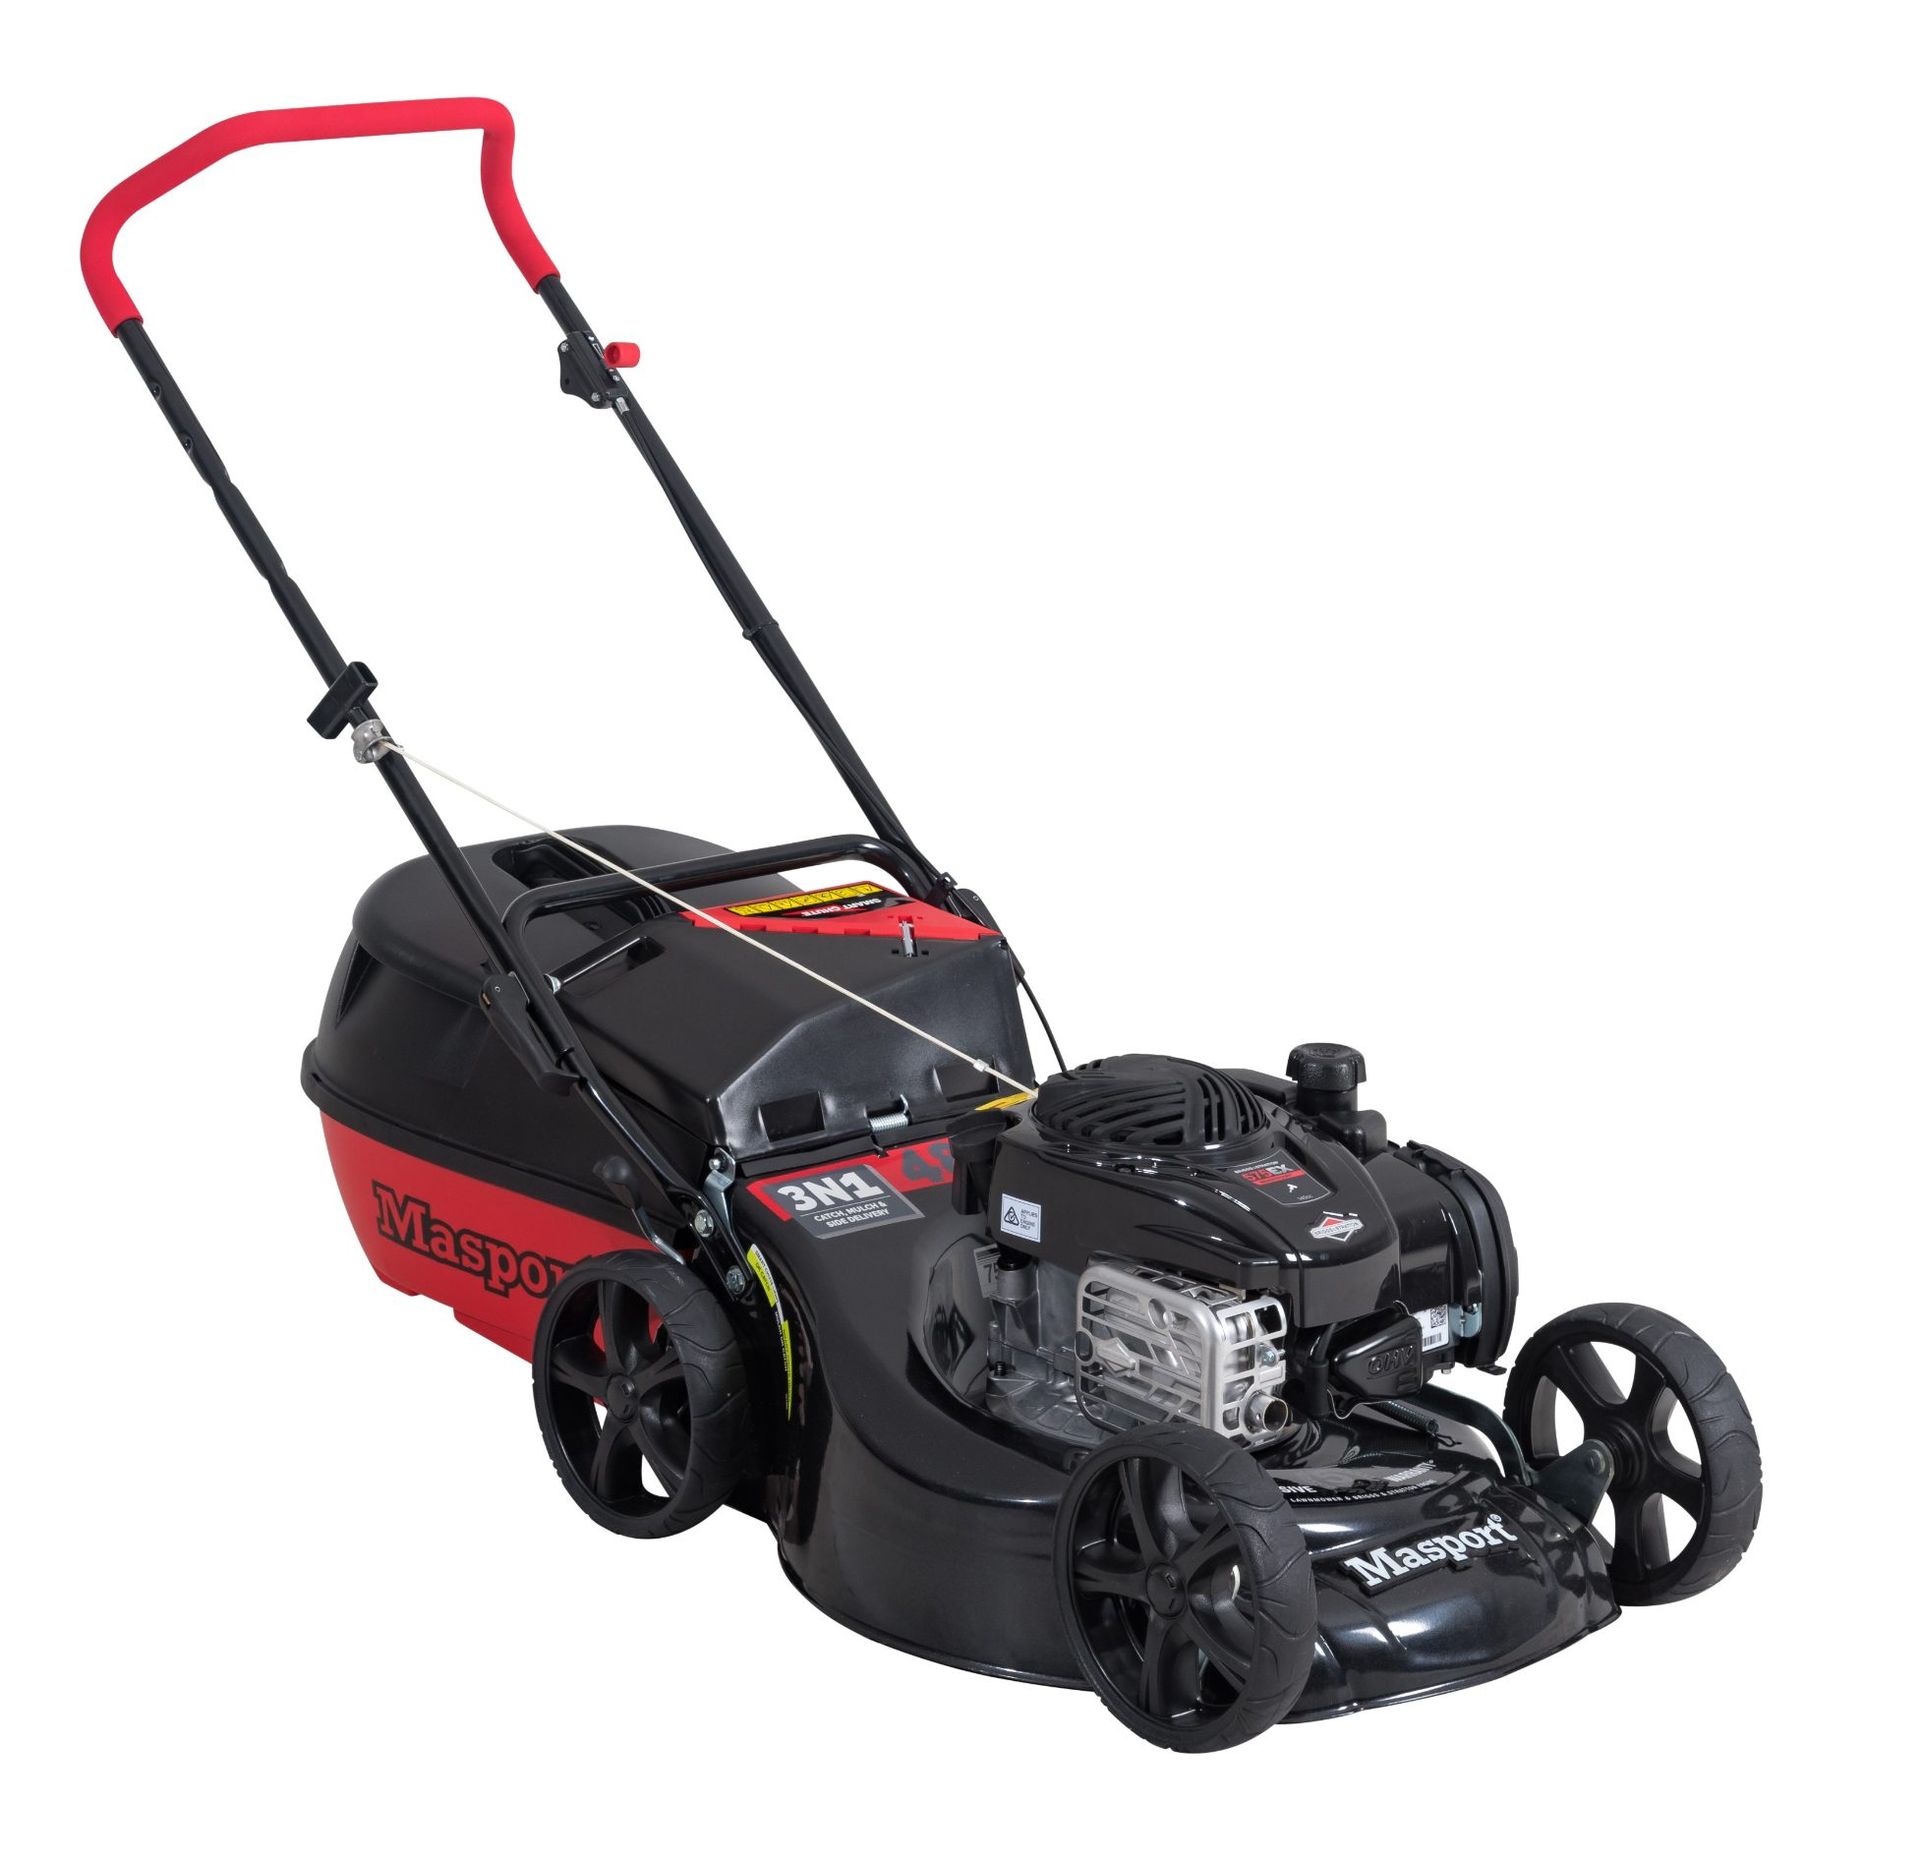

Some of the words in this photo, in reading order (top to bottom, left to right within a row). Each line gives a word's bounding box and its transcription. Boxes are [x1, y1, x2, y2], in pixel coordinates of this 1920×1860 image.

[777, 1171, 885, 1211] 3N1
[814, 1209, 848, 1222] CATCH,
[845, 1202, 879, 1215] MULCH
[826, 1217, 849, 1228] SIDE
[847, 1207, 890, 1223] DELIVERY
